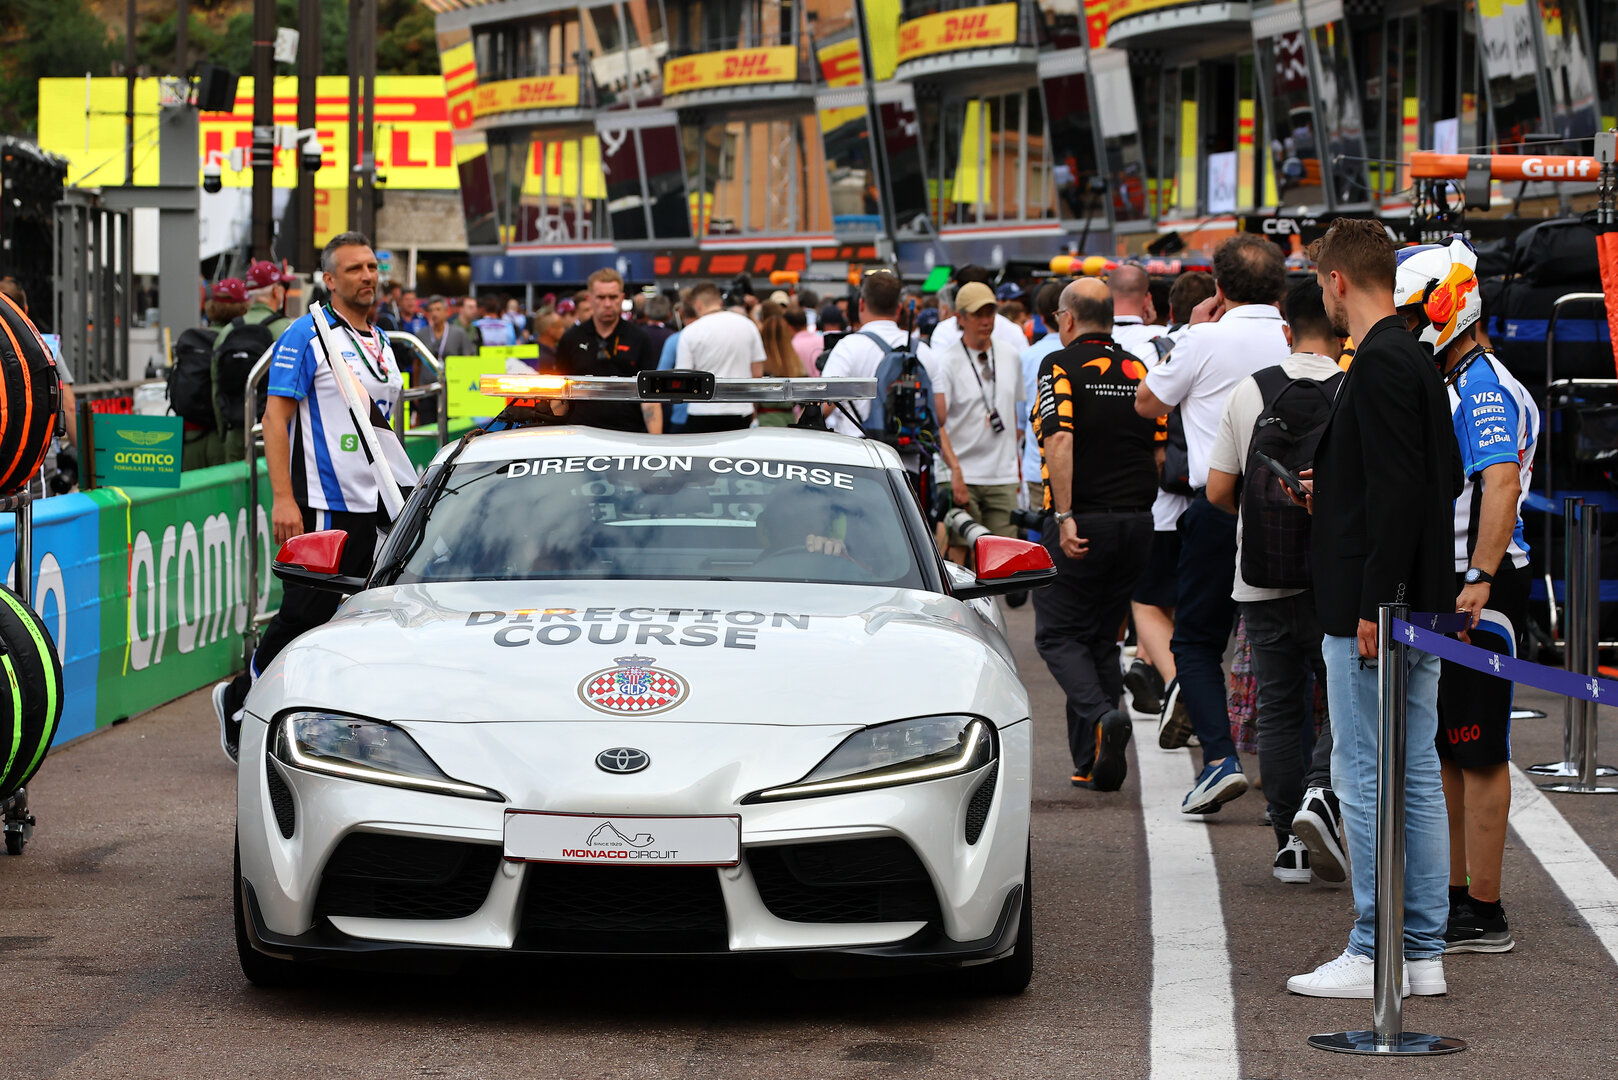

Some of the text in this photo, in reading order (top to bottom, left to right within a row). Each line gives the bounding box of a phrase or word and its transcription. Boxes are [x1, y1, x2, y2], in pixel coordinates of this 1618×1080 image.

[722, 54, 771, 78] DHL
[1522, 158, 1591, 177] Gulf
[1471, 392, 1504, 404] VISA
[1479, 434, 1511, 448] Red Bull
[114, 452, 175, 466] aramco
[506, 454, 855, 491] DIRECTION COURSE
[465, 606, 811, 631] DIRECTION
[493, 624, 760, 651] COURSE
[1448, 724, 1481, 745] UGO
